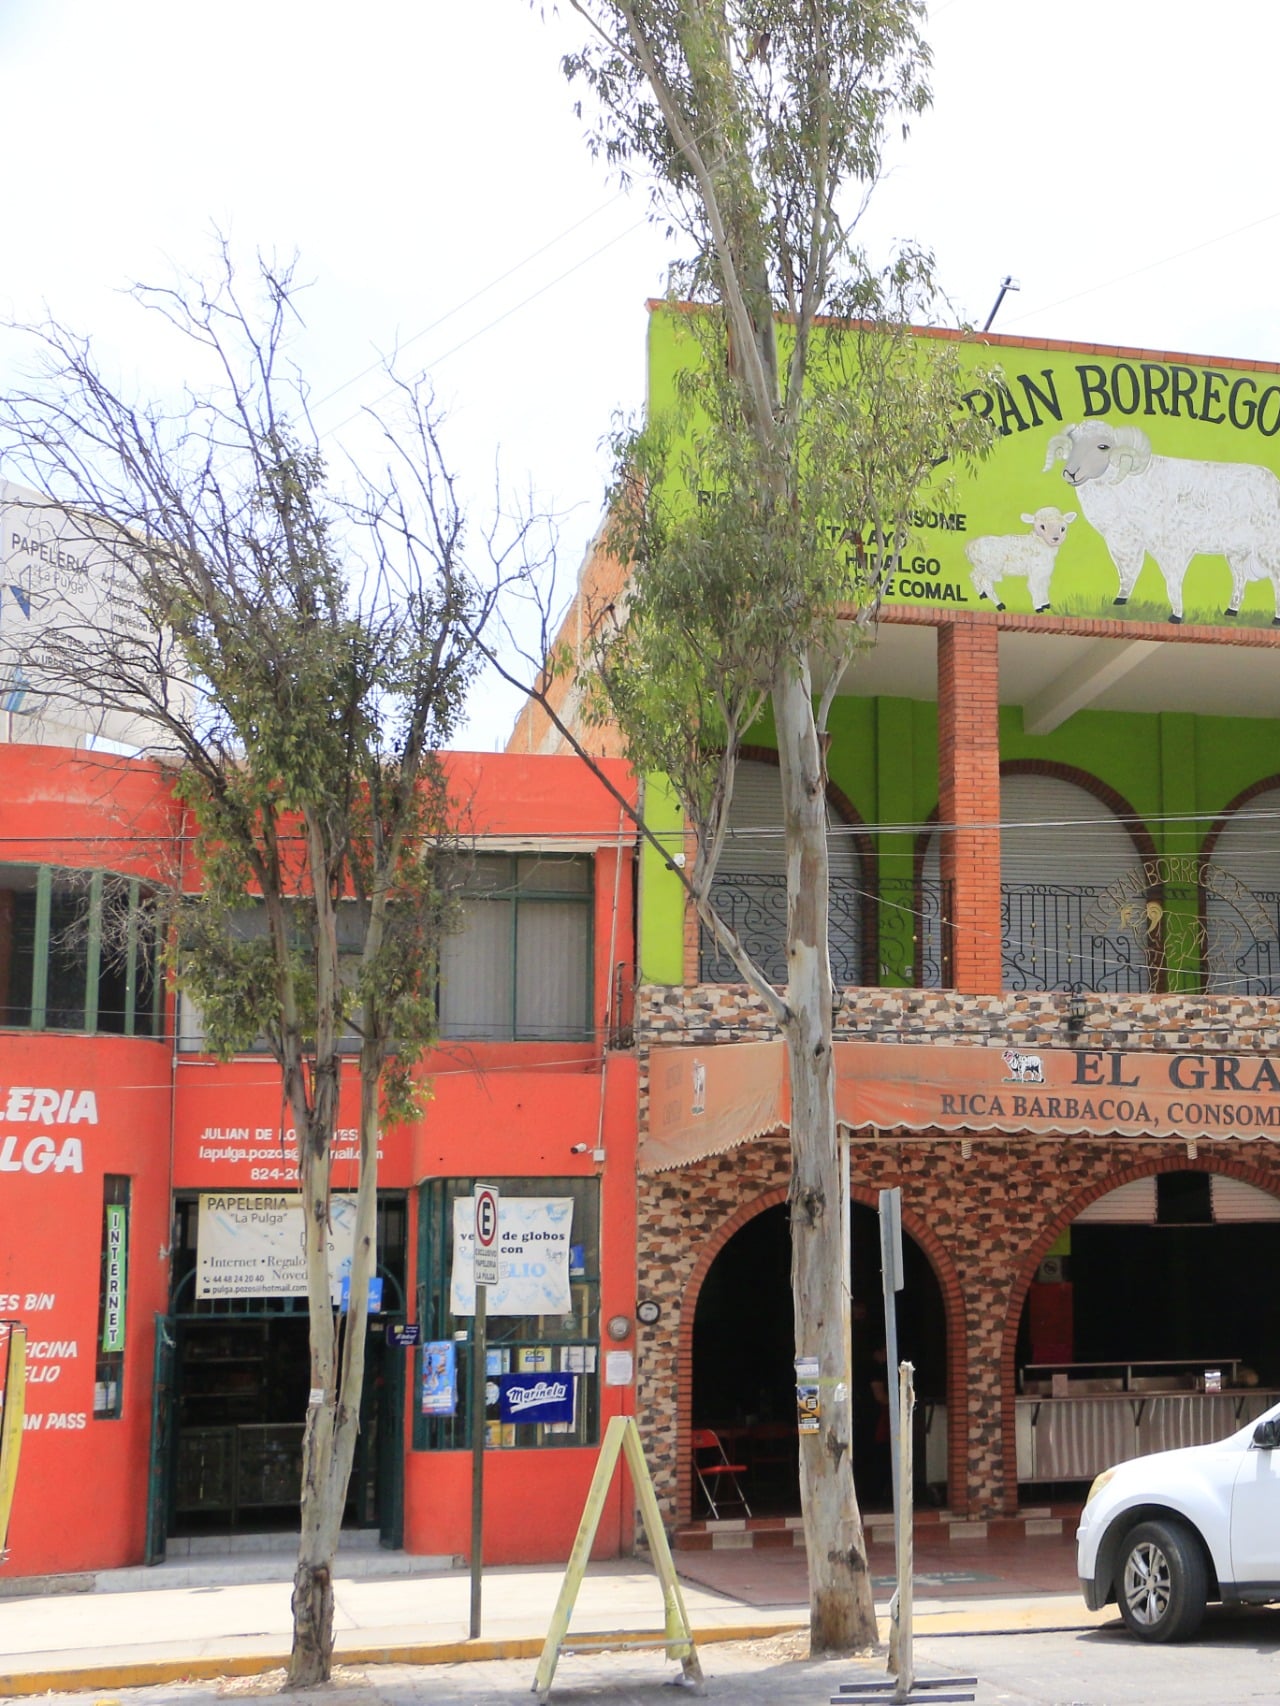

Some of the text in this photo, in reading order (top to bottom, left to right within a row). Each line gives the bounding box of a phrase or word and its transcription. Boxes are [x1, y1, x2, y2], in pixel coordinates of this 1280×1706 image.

[957, 369, 1063, 437] RAN
[899, 580, 968, 601] COMAL
[1071, 1051, 1141, 1087] EL
[0, 1086, 98, 1126] ERIA
[940, 1093, 1005, 1117] RICA
[1011, 1096, 1160, 1128] BARBACOA,
[201, 1128, 249, 1141] JULIAN
[255, 1128, 273, 1141] DE
[278, 1128, 297, 1142] LO
[207, 1197, 289, 1211] PAPELERIA
[230, 1213, 288, 1225] "La Pulga"
[482, 1201, 491, 1236] E
[502, 1231, 566, 1243] de globos
[500, 1246, 524, 1254] con
[210, 1256, 307, 1270] Internet Regalo
[500, 1262, 546, 1278] ELIO
[109, 1212, 120, 1342] INTERNET
[213, 1275, 222, 1283] 44
[255, 1274, 264, 1282] 40
[24, 1293, 56, 1312] B/N
[508, 1382, 567, 1403] Marinela
[45, 1413, 87, 1430] PASS
